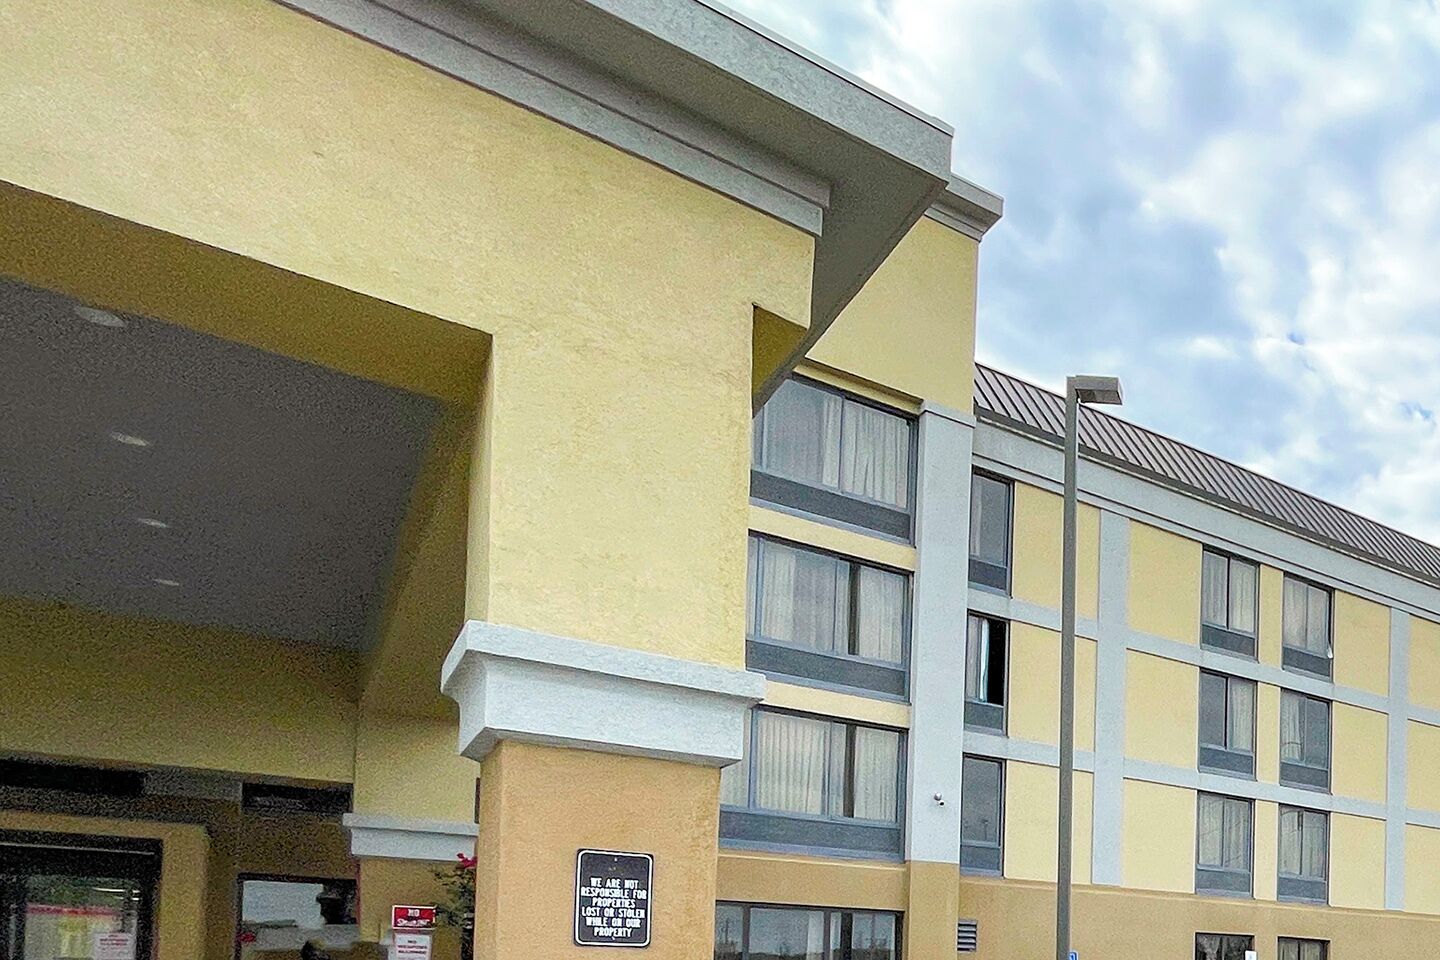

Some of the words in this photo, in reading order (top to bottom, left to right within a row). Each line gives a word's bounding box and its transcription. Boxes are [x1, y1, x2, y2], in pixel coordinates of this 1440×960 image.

[591, 878, 602, 887] WE
[606, 879, 621, 888] ARE
[625, 880, 639, 889] NOT
[581, 887, 629, 898] RESPONSIBLE
[634, 889, 647, 899] FOR
[593, 897, 636, 908] PROPERTIES
[582, 907, 601, 917] LOST
[605, 908, 615, 917] OR
[619, 908, 645, 918] STOLEN
[587, 917, 608, 927] WHILE
[612, 918, 622, 927] ON
[627, 918, 641, 928] OUR
[594, 927, 633, 937] PROPERTY
